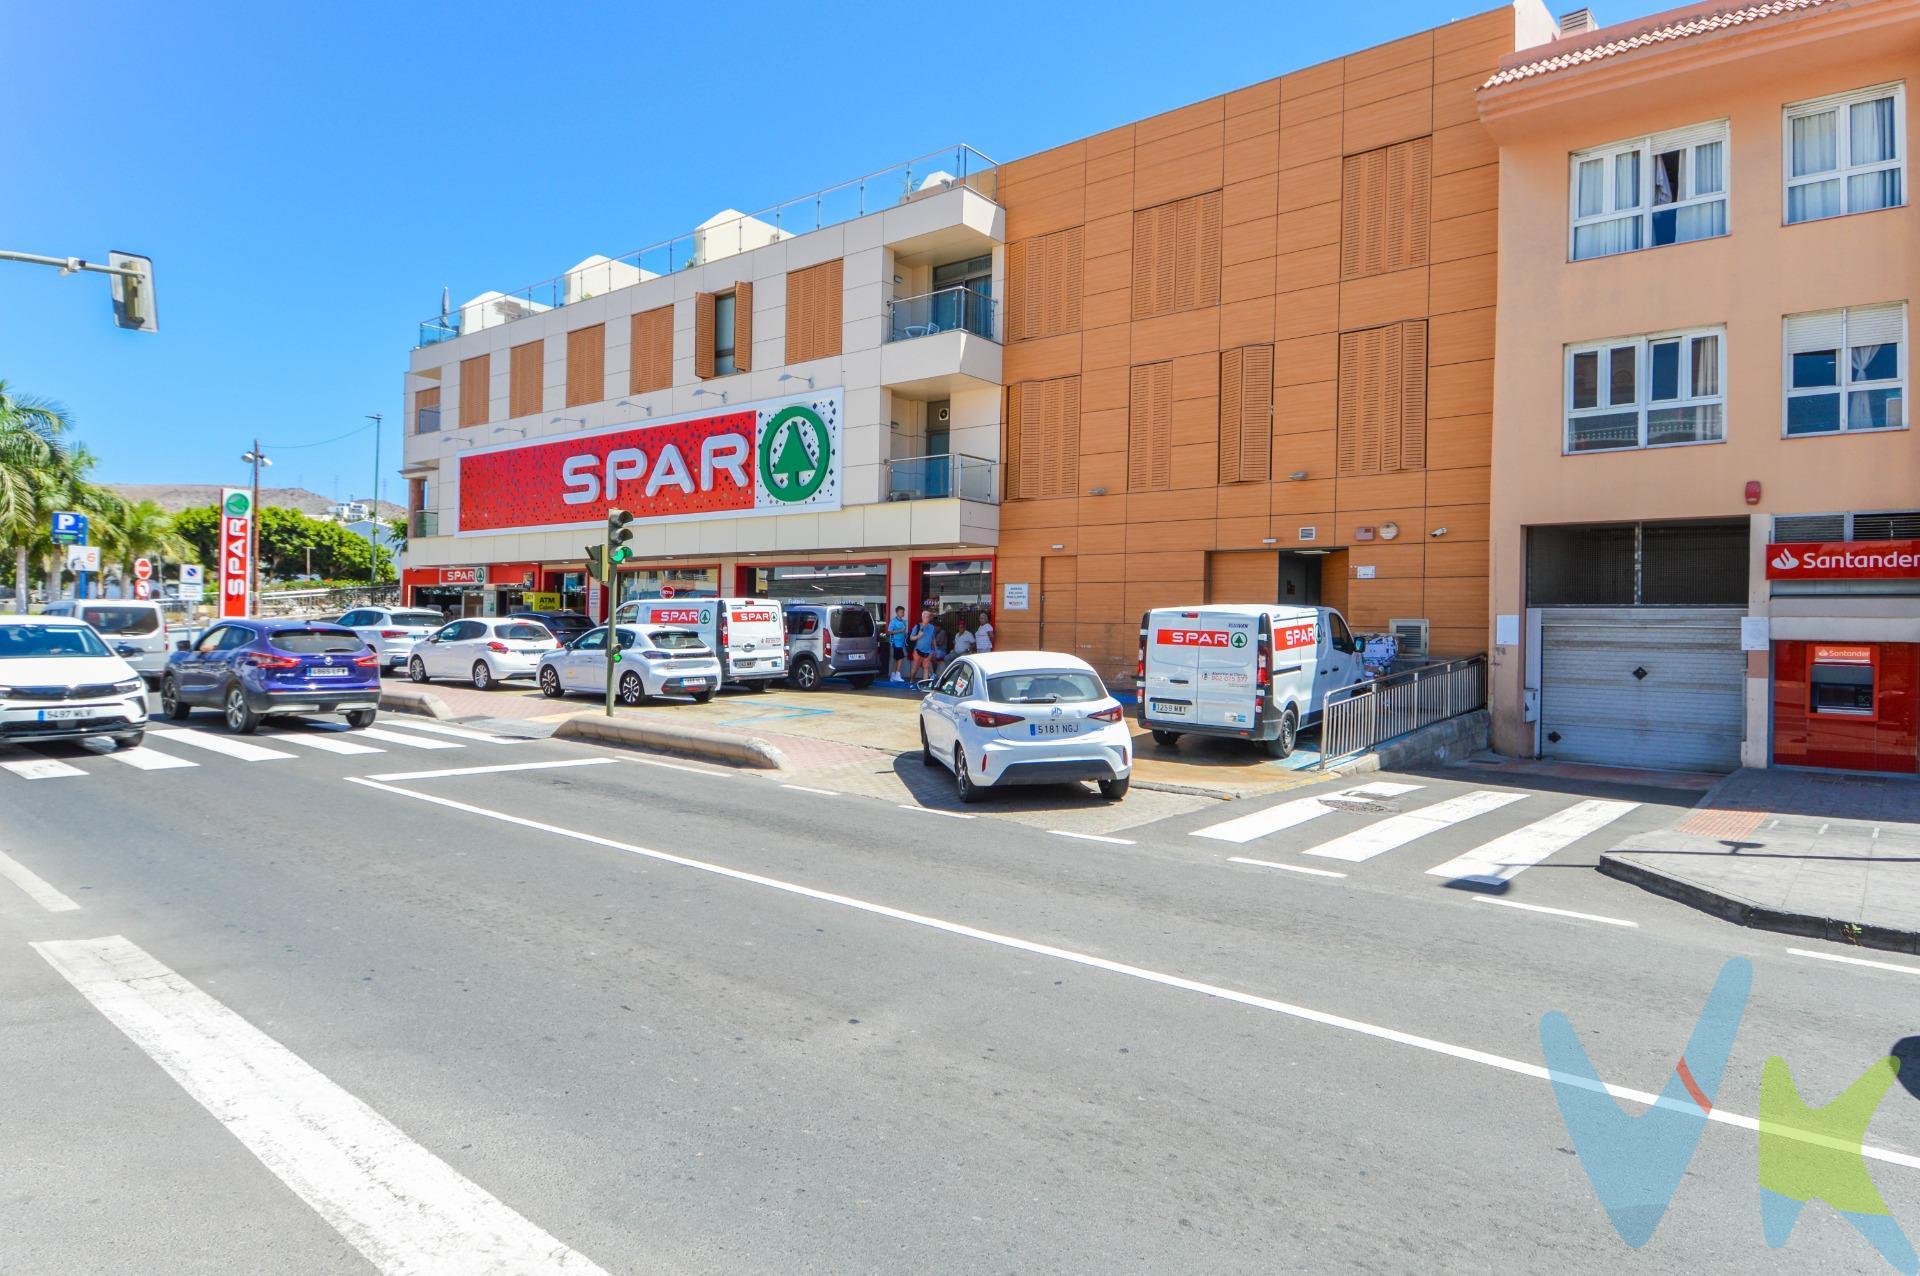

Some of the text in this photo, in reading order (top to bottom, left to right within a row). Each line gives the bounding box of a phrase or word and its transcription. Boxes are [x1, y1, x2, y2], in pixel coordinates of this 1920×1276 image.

[562, 433, 750, 505] SPAR
[58, 514, 76, 530] P
[227, 518, 247, 596] SPAR
[1803, 552, 1920, 569] Santander
[447, 570, 475, 582] SPAR
[660, 611, 699, 622] SPAR
[740, 613, 770, 621] SPAR
[1171, 632, 1228, 645] SPAR
[1285, 627, 1315, 646] SPAR
[1038, 723, 1079, 734] 5181 NGJ
